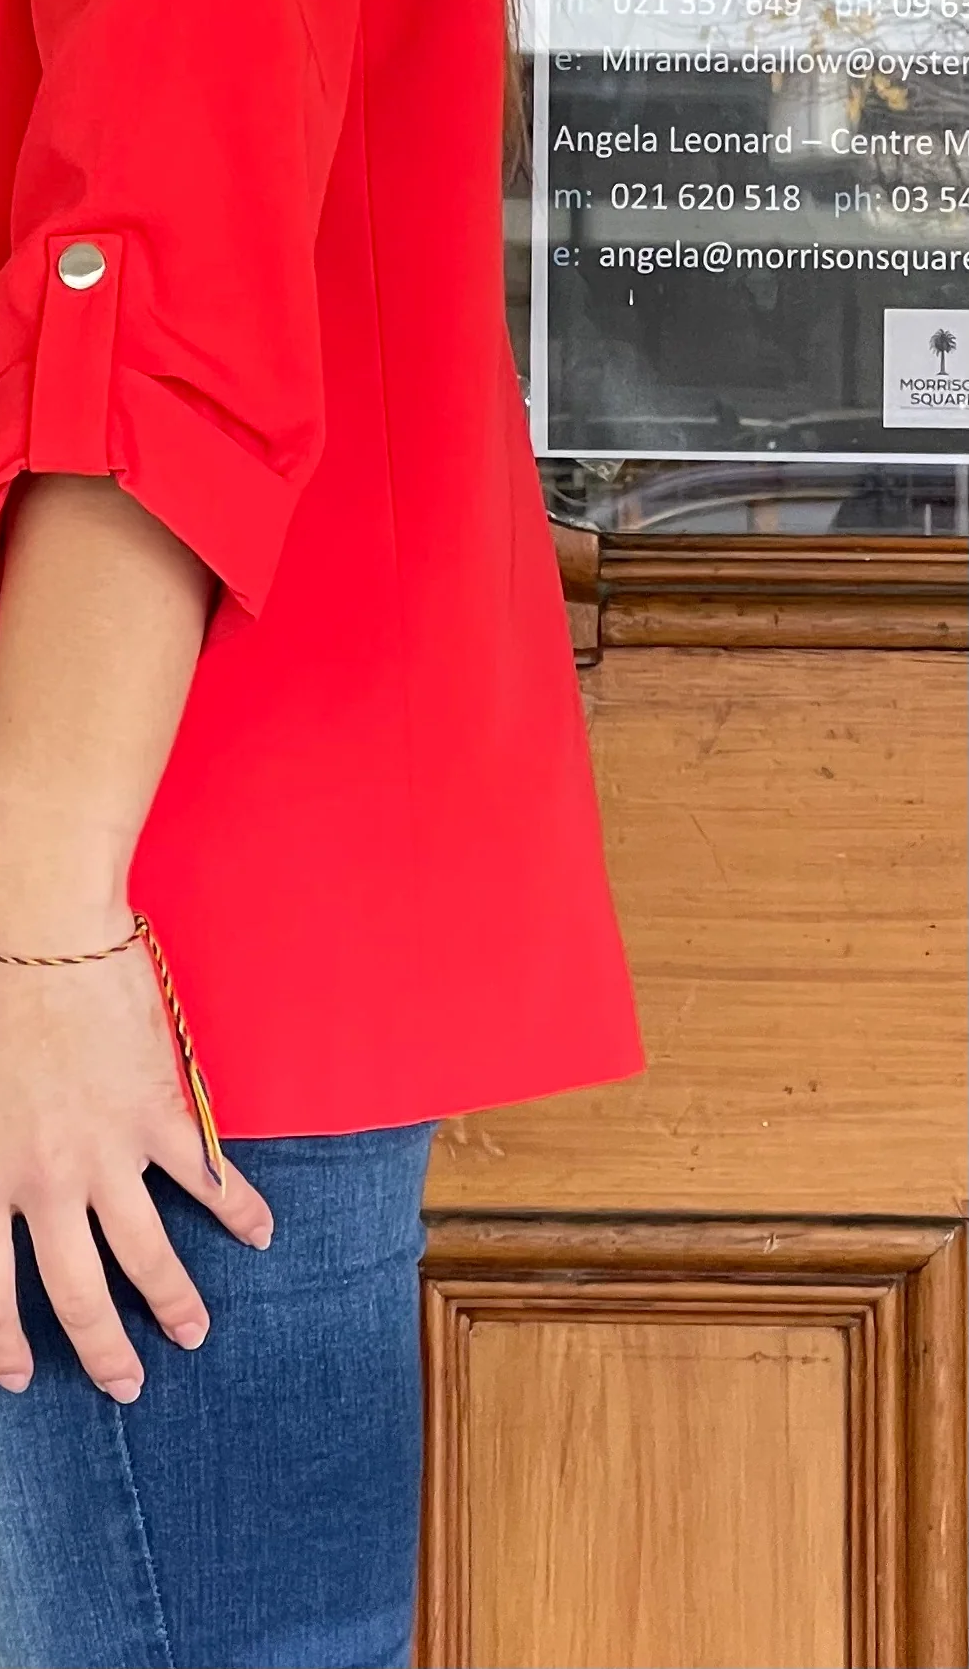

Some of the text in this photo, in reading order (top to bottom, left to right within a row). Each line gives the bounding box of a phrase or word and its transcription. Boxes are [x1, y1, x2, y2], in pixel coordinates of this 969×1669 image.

[554, 49, 582, 71] e:
[554, 124, 658, 158] Angela
[670, 126, 793, 155] Leonard
[830, 128, 933, 156] Centre
[553, 187, 593, 210] m:
[611, 183, 667, 212] 021
[678, 184, 734, 212] 620
[744, 184, 801, 212] 518
[834, 183, 882, 218] ph:
[891, 185, 929, 213] 03
[553, 245, 581, 267] e:
[910, 392, 969, 407] SQUAR
